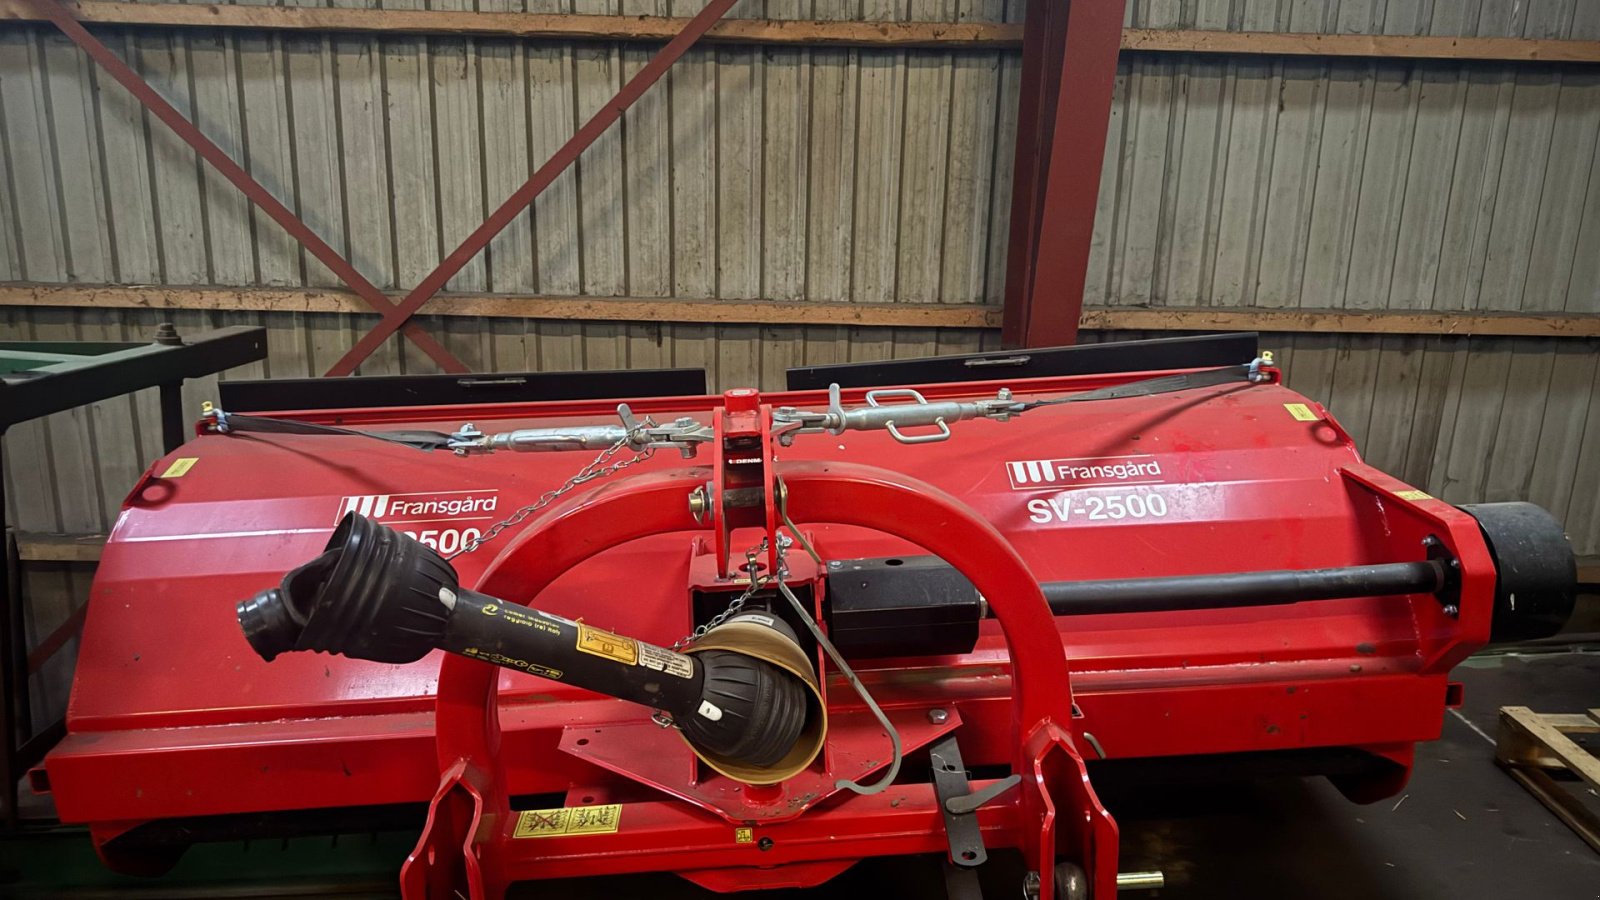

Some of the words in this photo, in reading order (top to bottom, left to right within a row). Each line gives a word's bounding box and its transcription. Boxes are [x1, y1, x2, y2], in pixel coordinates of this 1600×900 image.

[1057, 460, 1162, 480] Fransgård
[389, 496, 498, 516] Fransgård
[1027, 494, 1168, 524] SV-2500
